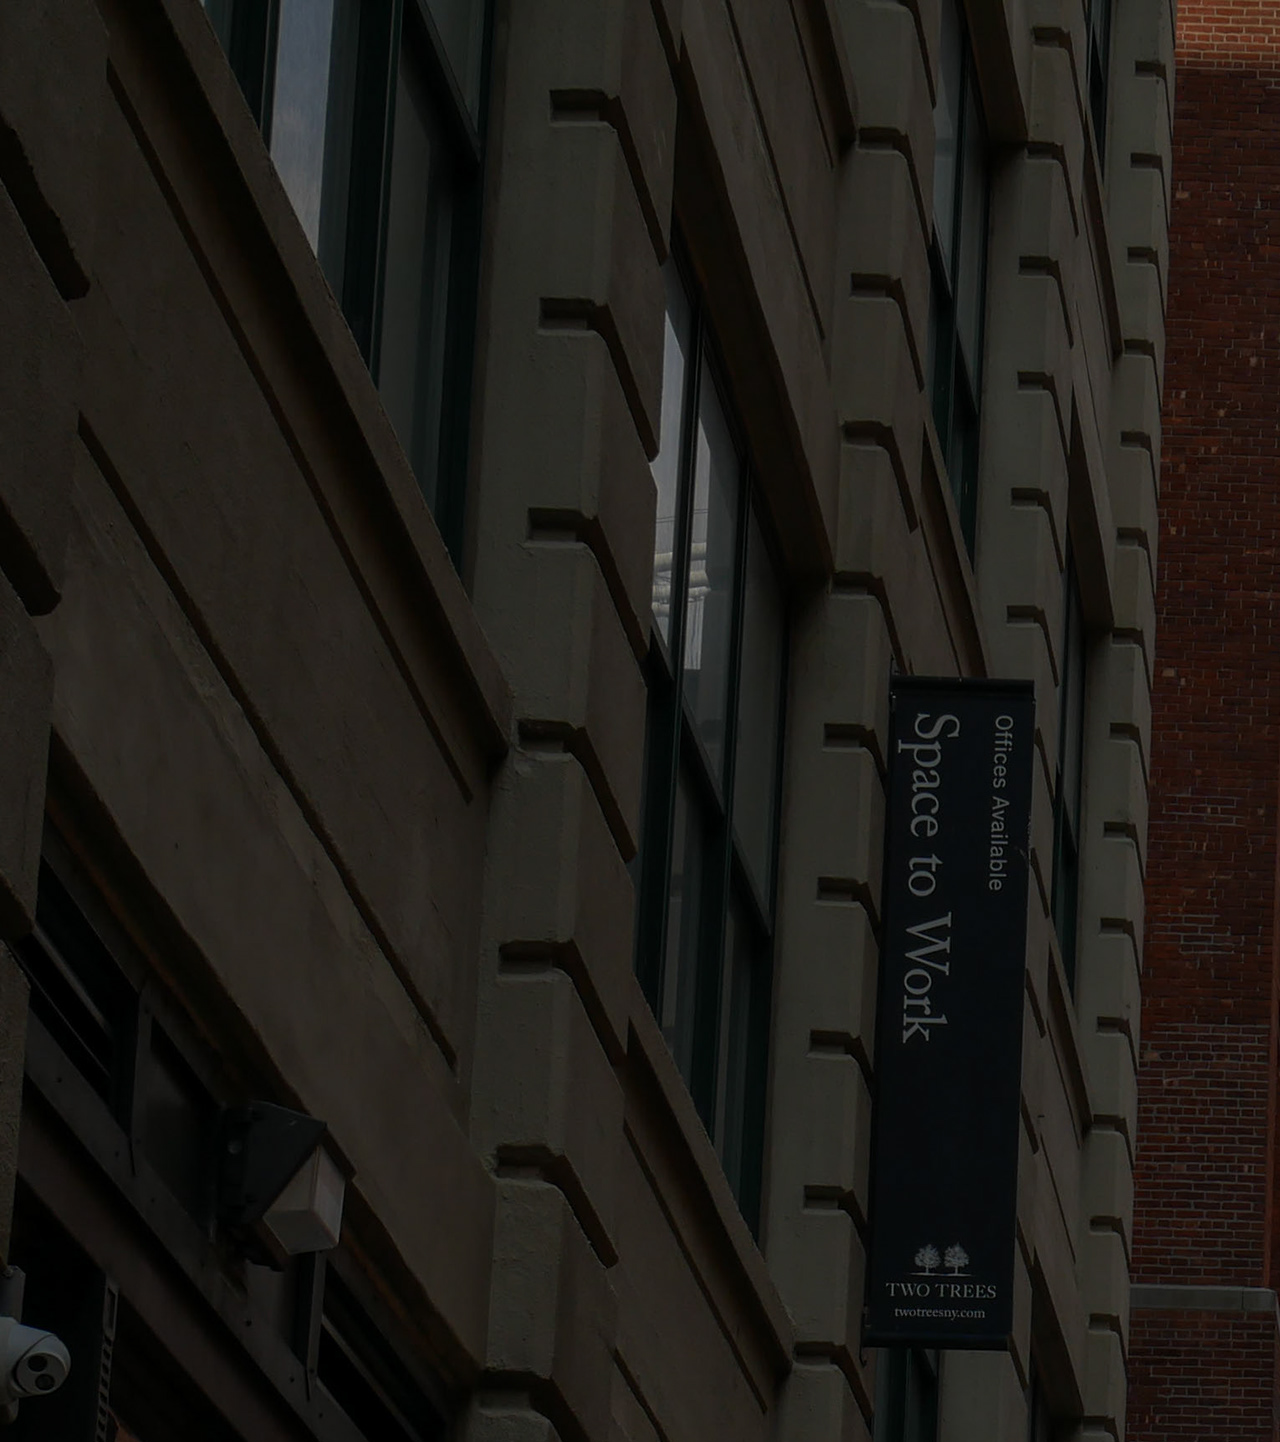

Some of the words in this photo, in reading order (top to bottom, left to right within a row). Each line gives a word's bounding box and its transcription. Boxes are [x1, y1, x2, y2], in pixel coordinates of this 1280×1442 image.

[898, 713, 961, 838] Space
[993, 715, 1014, 789] Offices
[908, 853, 944, 897] to
[988, 796, 1010, 891] Available
[903, 911, 953, 1044] Work
[886, 1282, 931, 1298] TWO
[935, 1283, 997, 1299] TREES
[894, 1307, 986, 1321] twotreesny.com
